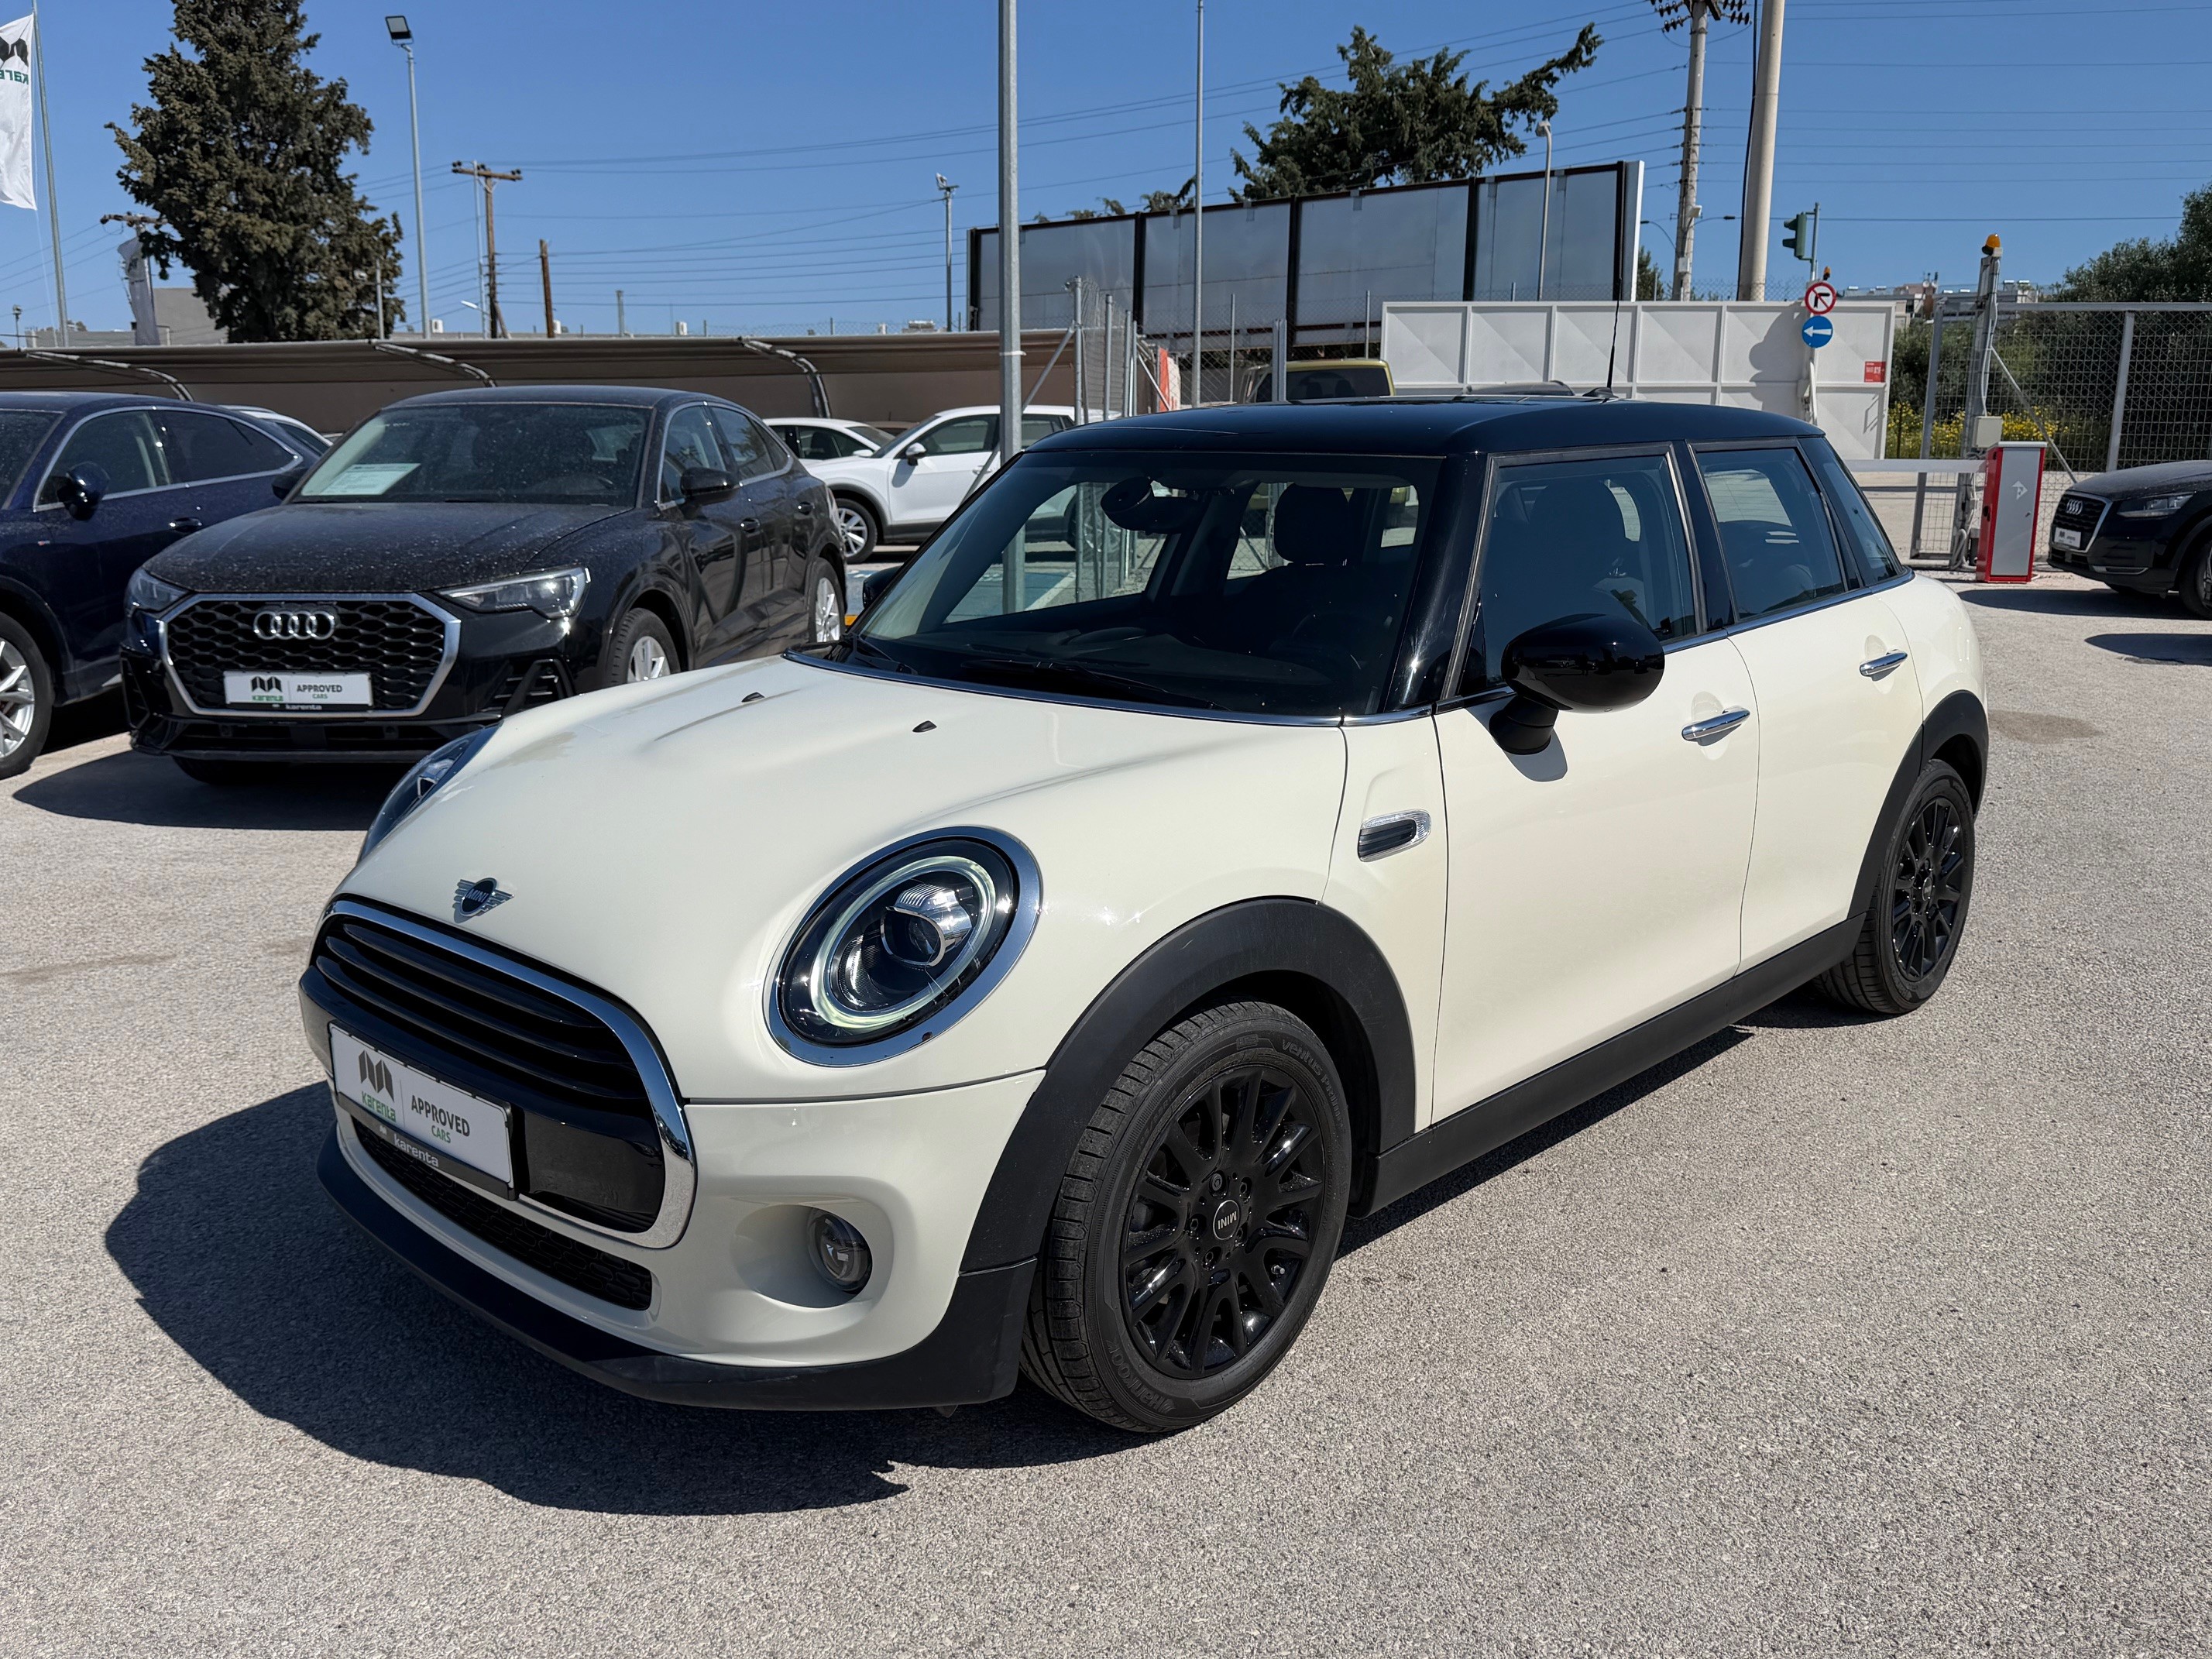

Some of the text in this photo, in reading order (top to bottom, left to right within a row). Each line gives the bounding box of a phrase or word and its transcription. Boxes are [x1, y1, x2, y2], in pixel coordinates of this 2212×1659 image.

[296, 684, 342, 693] APPROVED
[465, 888, 489, 903] MINI
[410, 1094, 470, 1137] APPROVED
[431, 1125, 452, 1144] CARS
[393, 1133, 439, 1168] karenta
[1218, 1211, 1238, 1230] MINI
